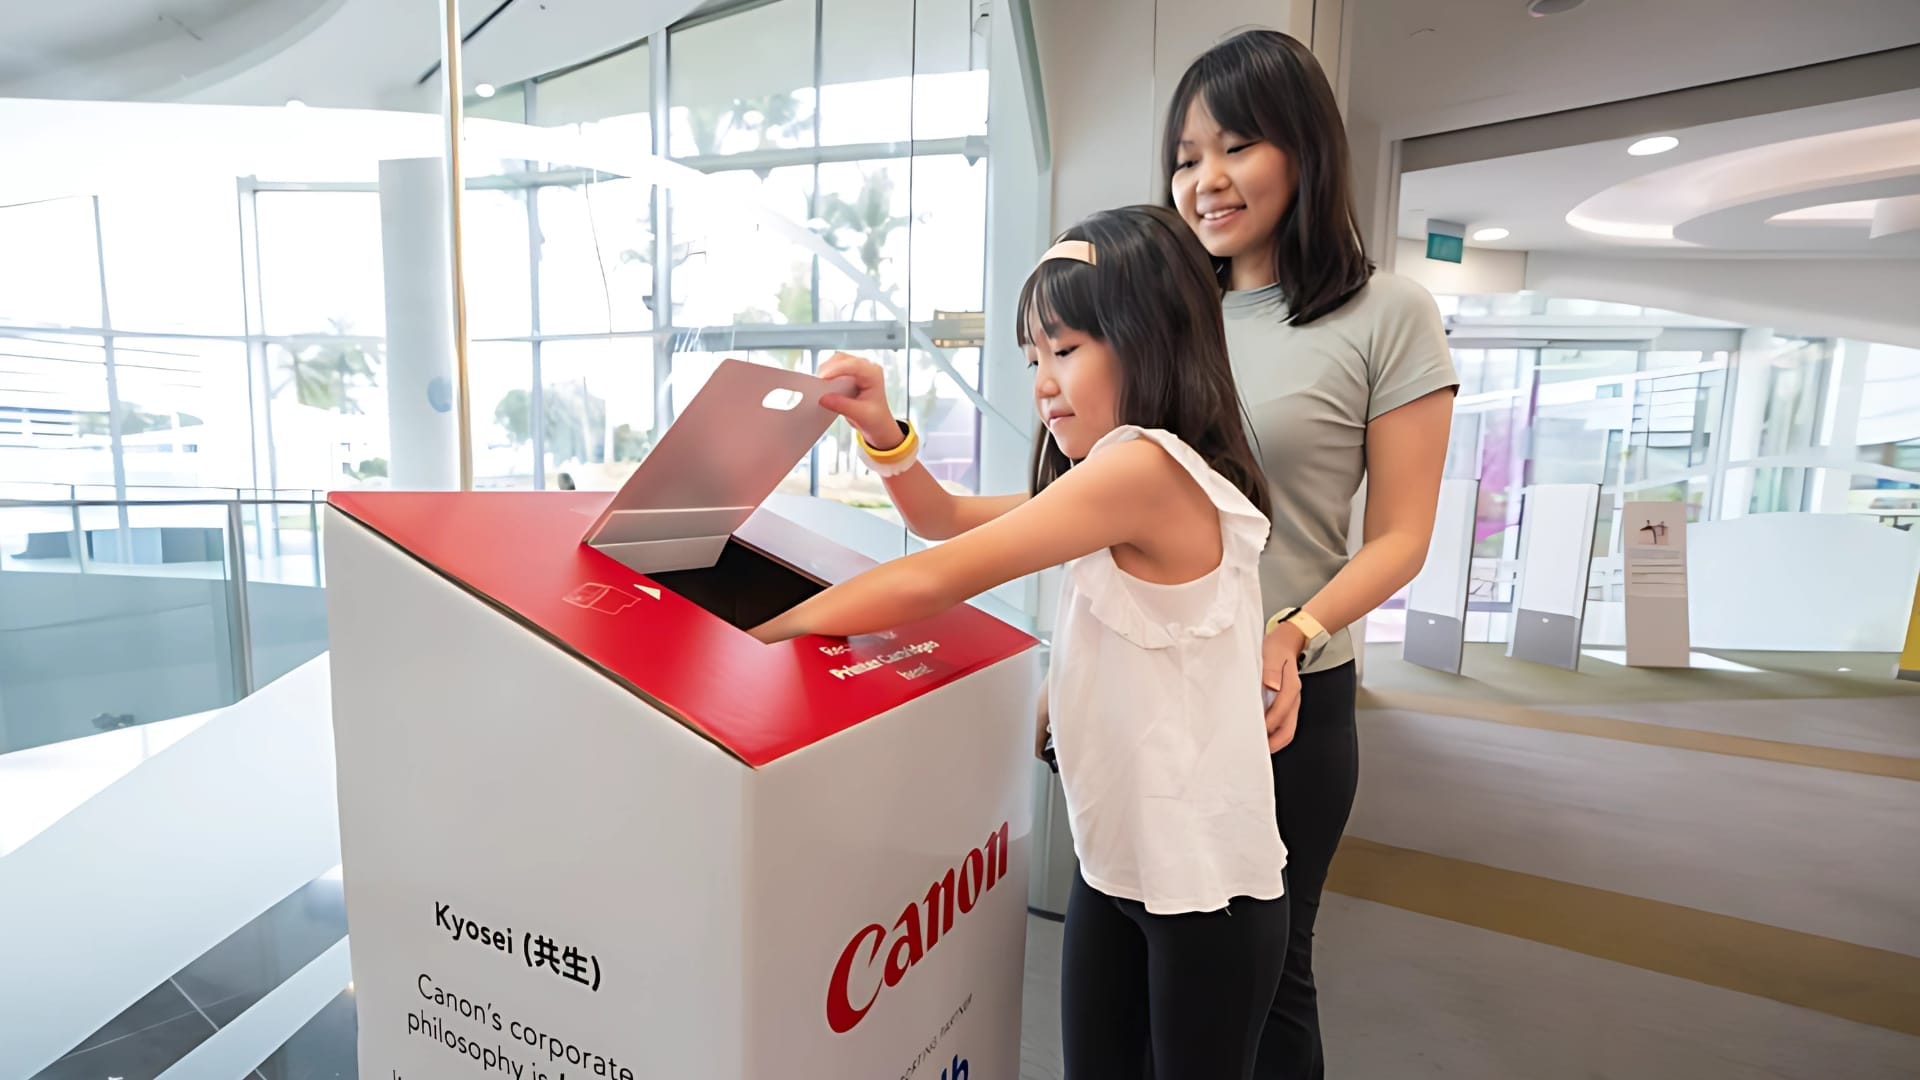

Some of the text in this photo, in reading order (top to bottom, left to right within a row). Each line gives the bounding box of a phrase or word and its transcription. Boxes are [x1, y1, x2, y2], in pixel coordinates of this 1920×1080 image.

[434, 901, 601, 991] Kyosei (共生)
[826, 821, 1008, 1034] Canon
[407, 1010, 523, 1080] philosophy
[417, 973, 634, 1080] Canon's corporate
